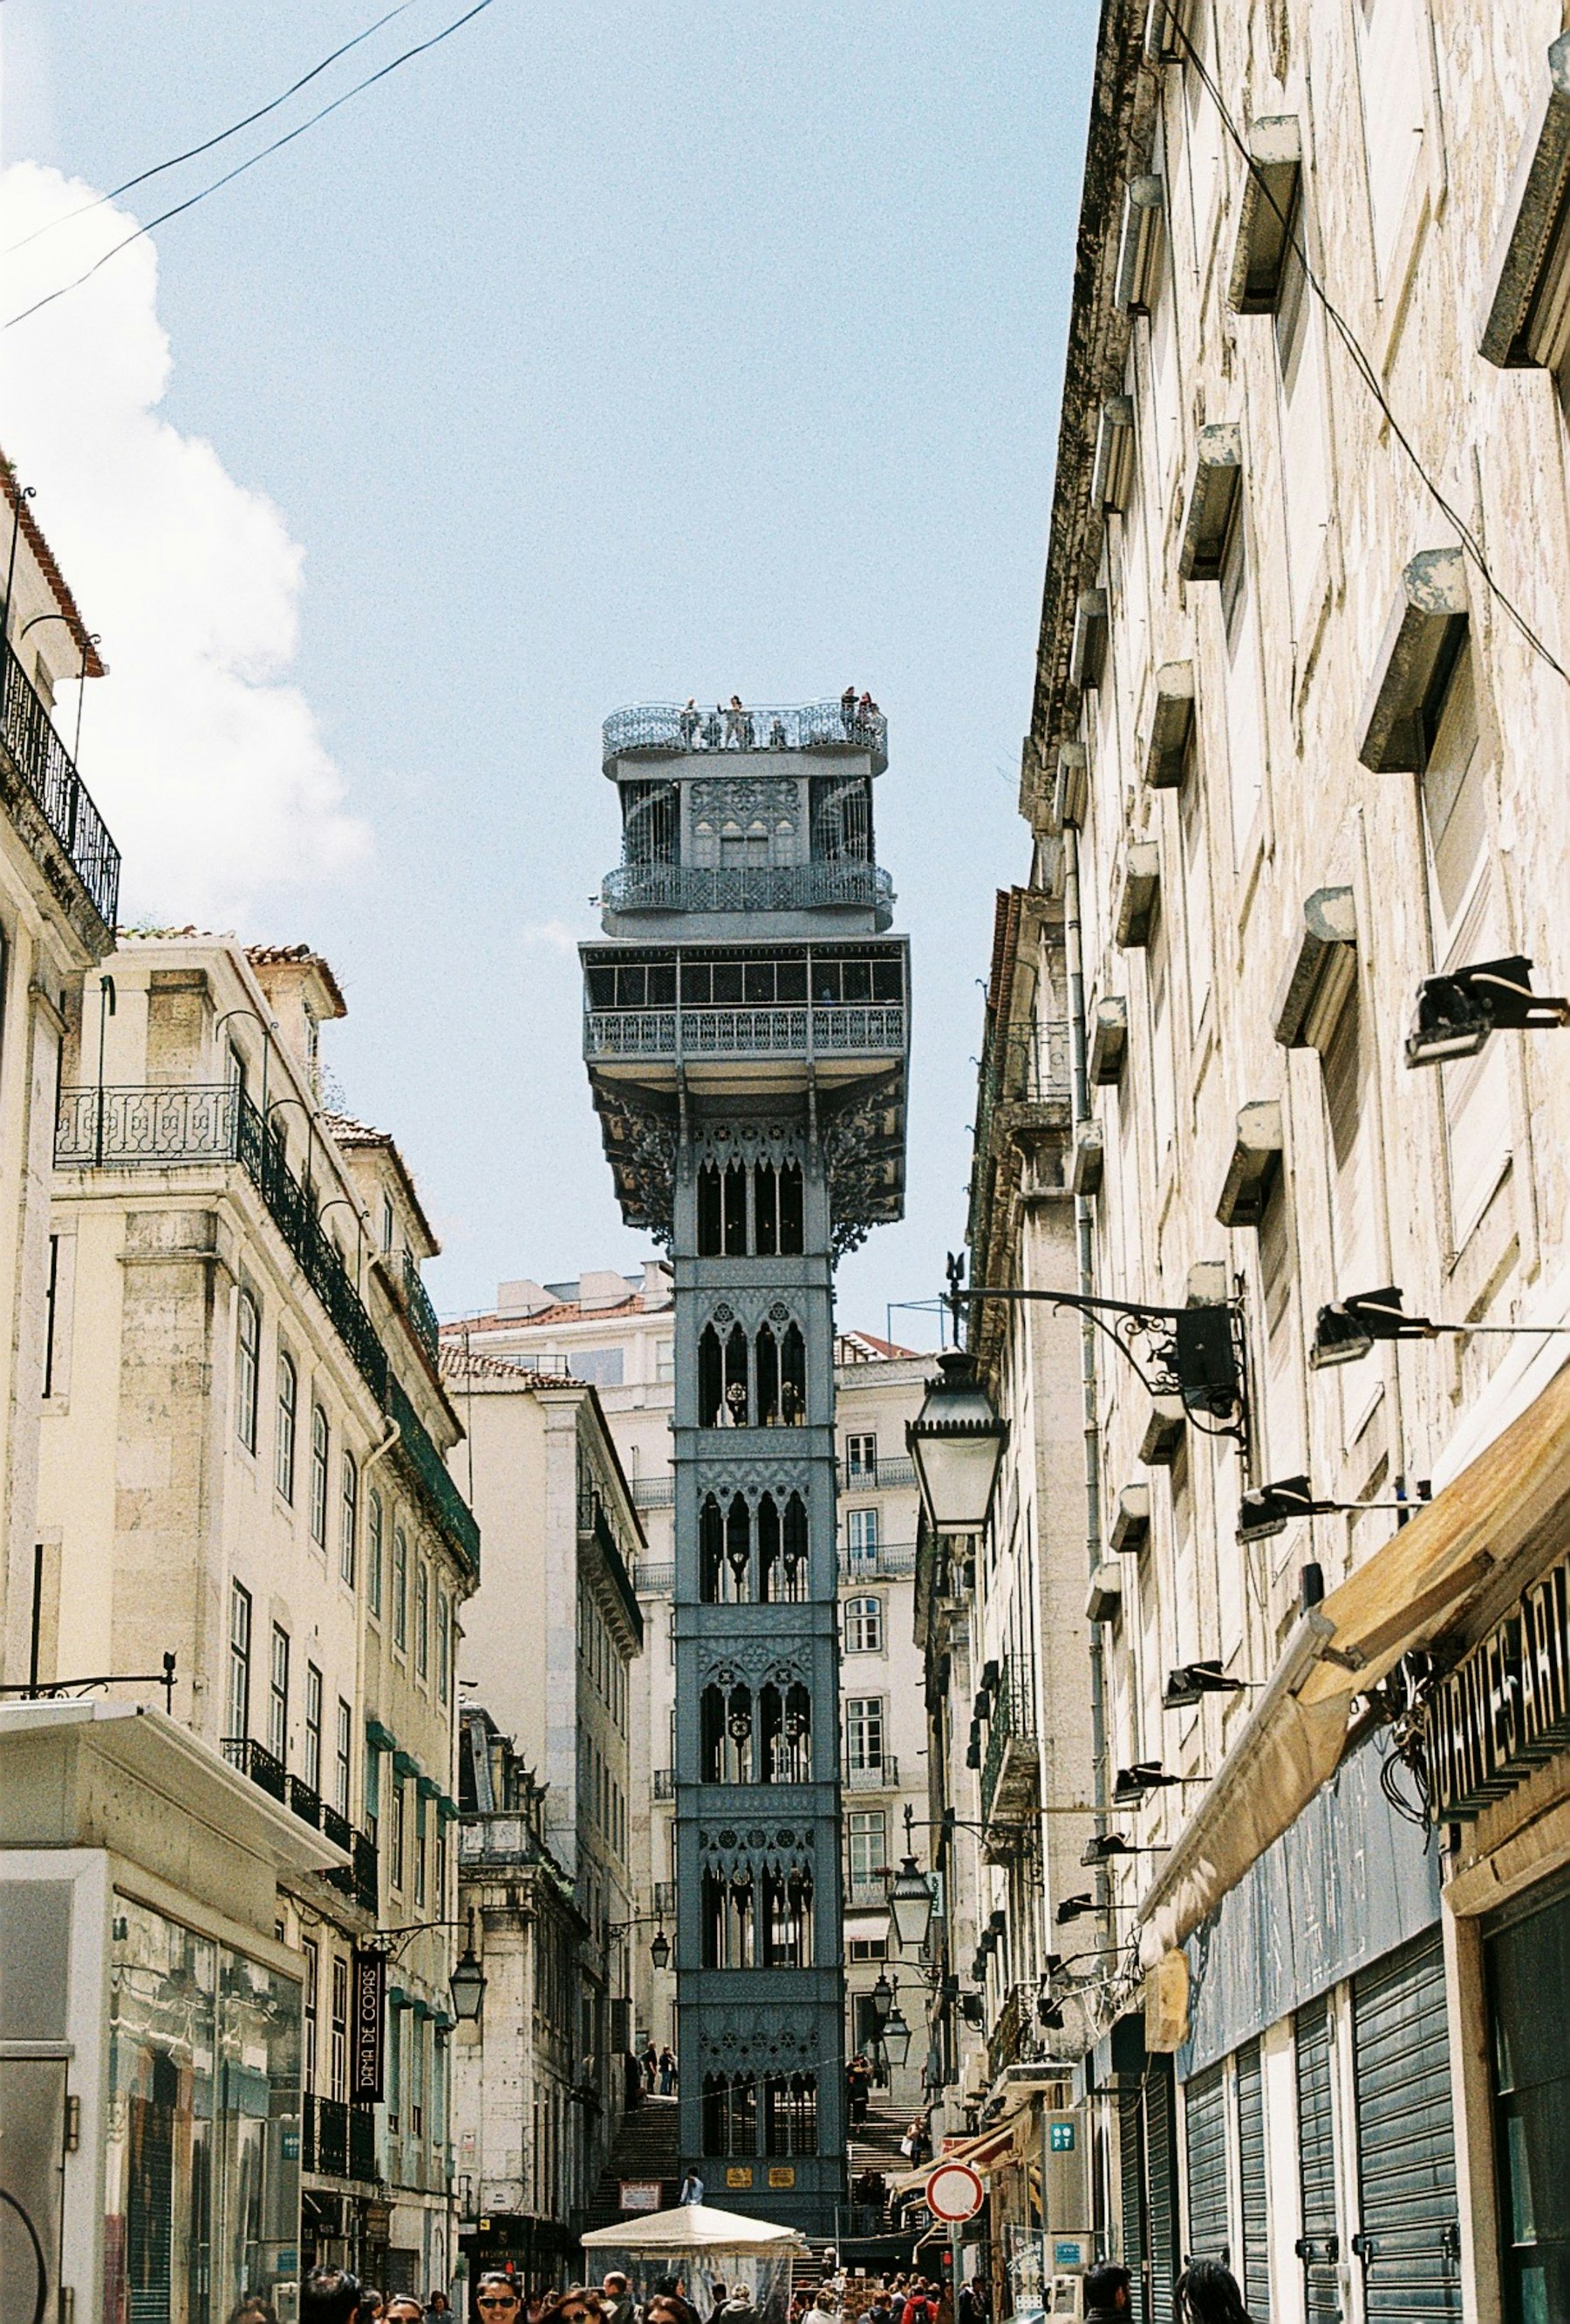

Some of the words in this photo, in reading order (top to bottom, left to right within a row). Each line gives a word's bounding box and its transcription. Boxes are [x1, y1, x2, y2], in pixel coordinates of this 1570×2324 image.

[363, 1969, 376, 2021] COPAS
[362, 2027, 375, 2043] DE
[361, 2049, 374, 2086] DAMA
[1054, 2138, 1069, 2148] PT
